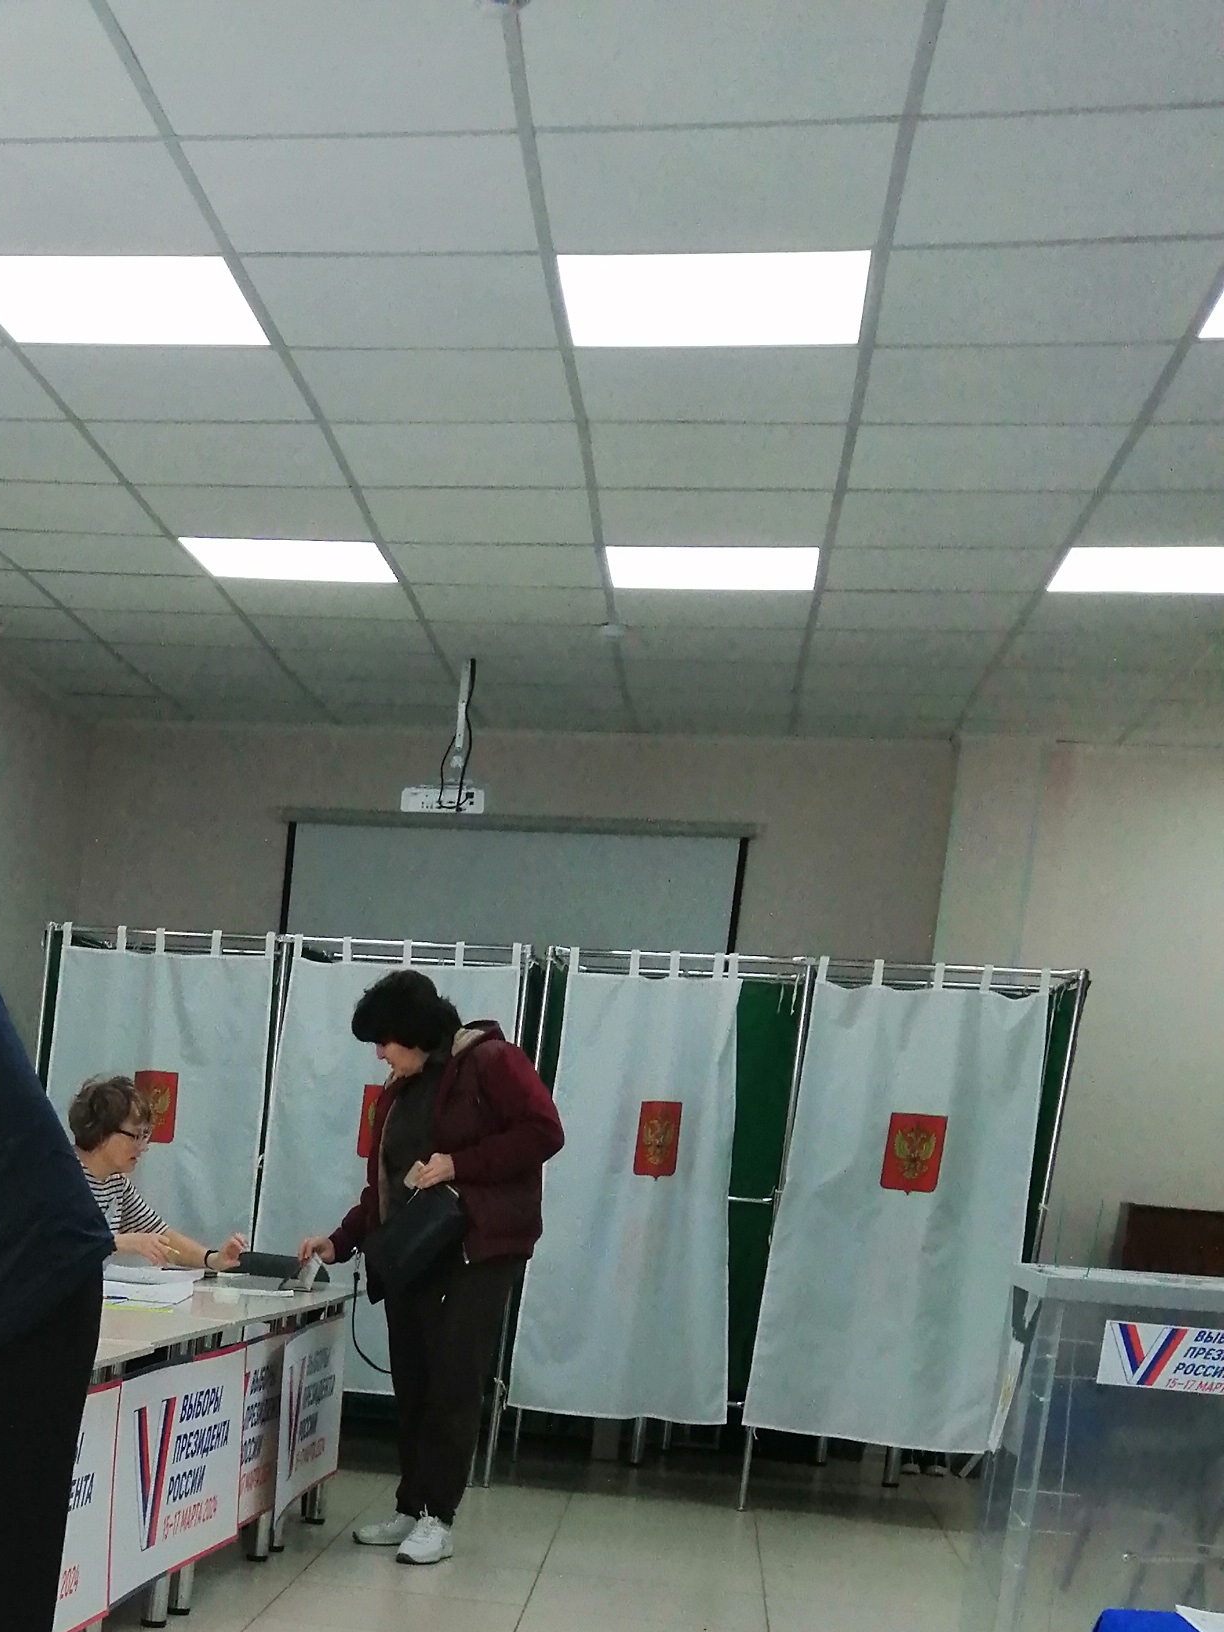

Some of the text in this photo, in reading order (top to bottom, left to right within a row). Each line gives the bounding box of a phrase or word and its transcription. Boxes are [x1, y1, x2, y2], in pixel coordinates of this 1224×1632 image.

[1183, 1346, 1224, 1361] ПРЕЗ
[1194, 1330, 1224, 1344] ВЫБ
[179, 1385, 224, 1423] ВЫБОРЫ
[1195, 1381, 1224, 1393] МАР
[172, 1419, 230, 1464] ПРЕЗИДЕНТА
[166, 1465, 206, 1505] РОССИИ
[179, 1500, 203, 1533] МАРТА
[202, 1495, 218, 1523] 2024
[60, 1564, 79, 1600] 2024
